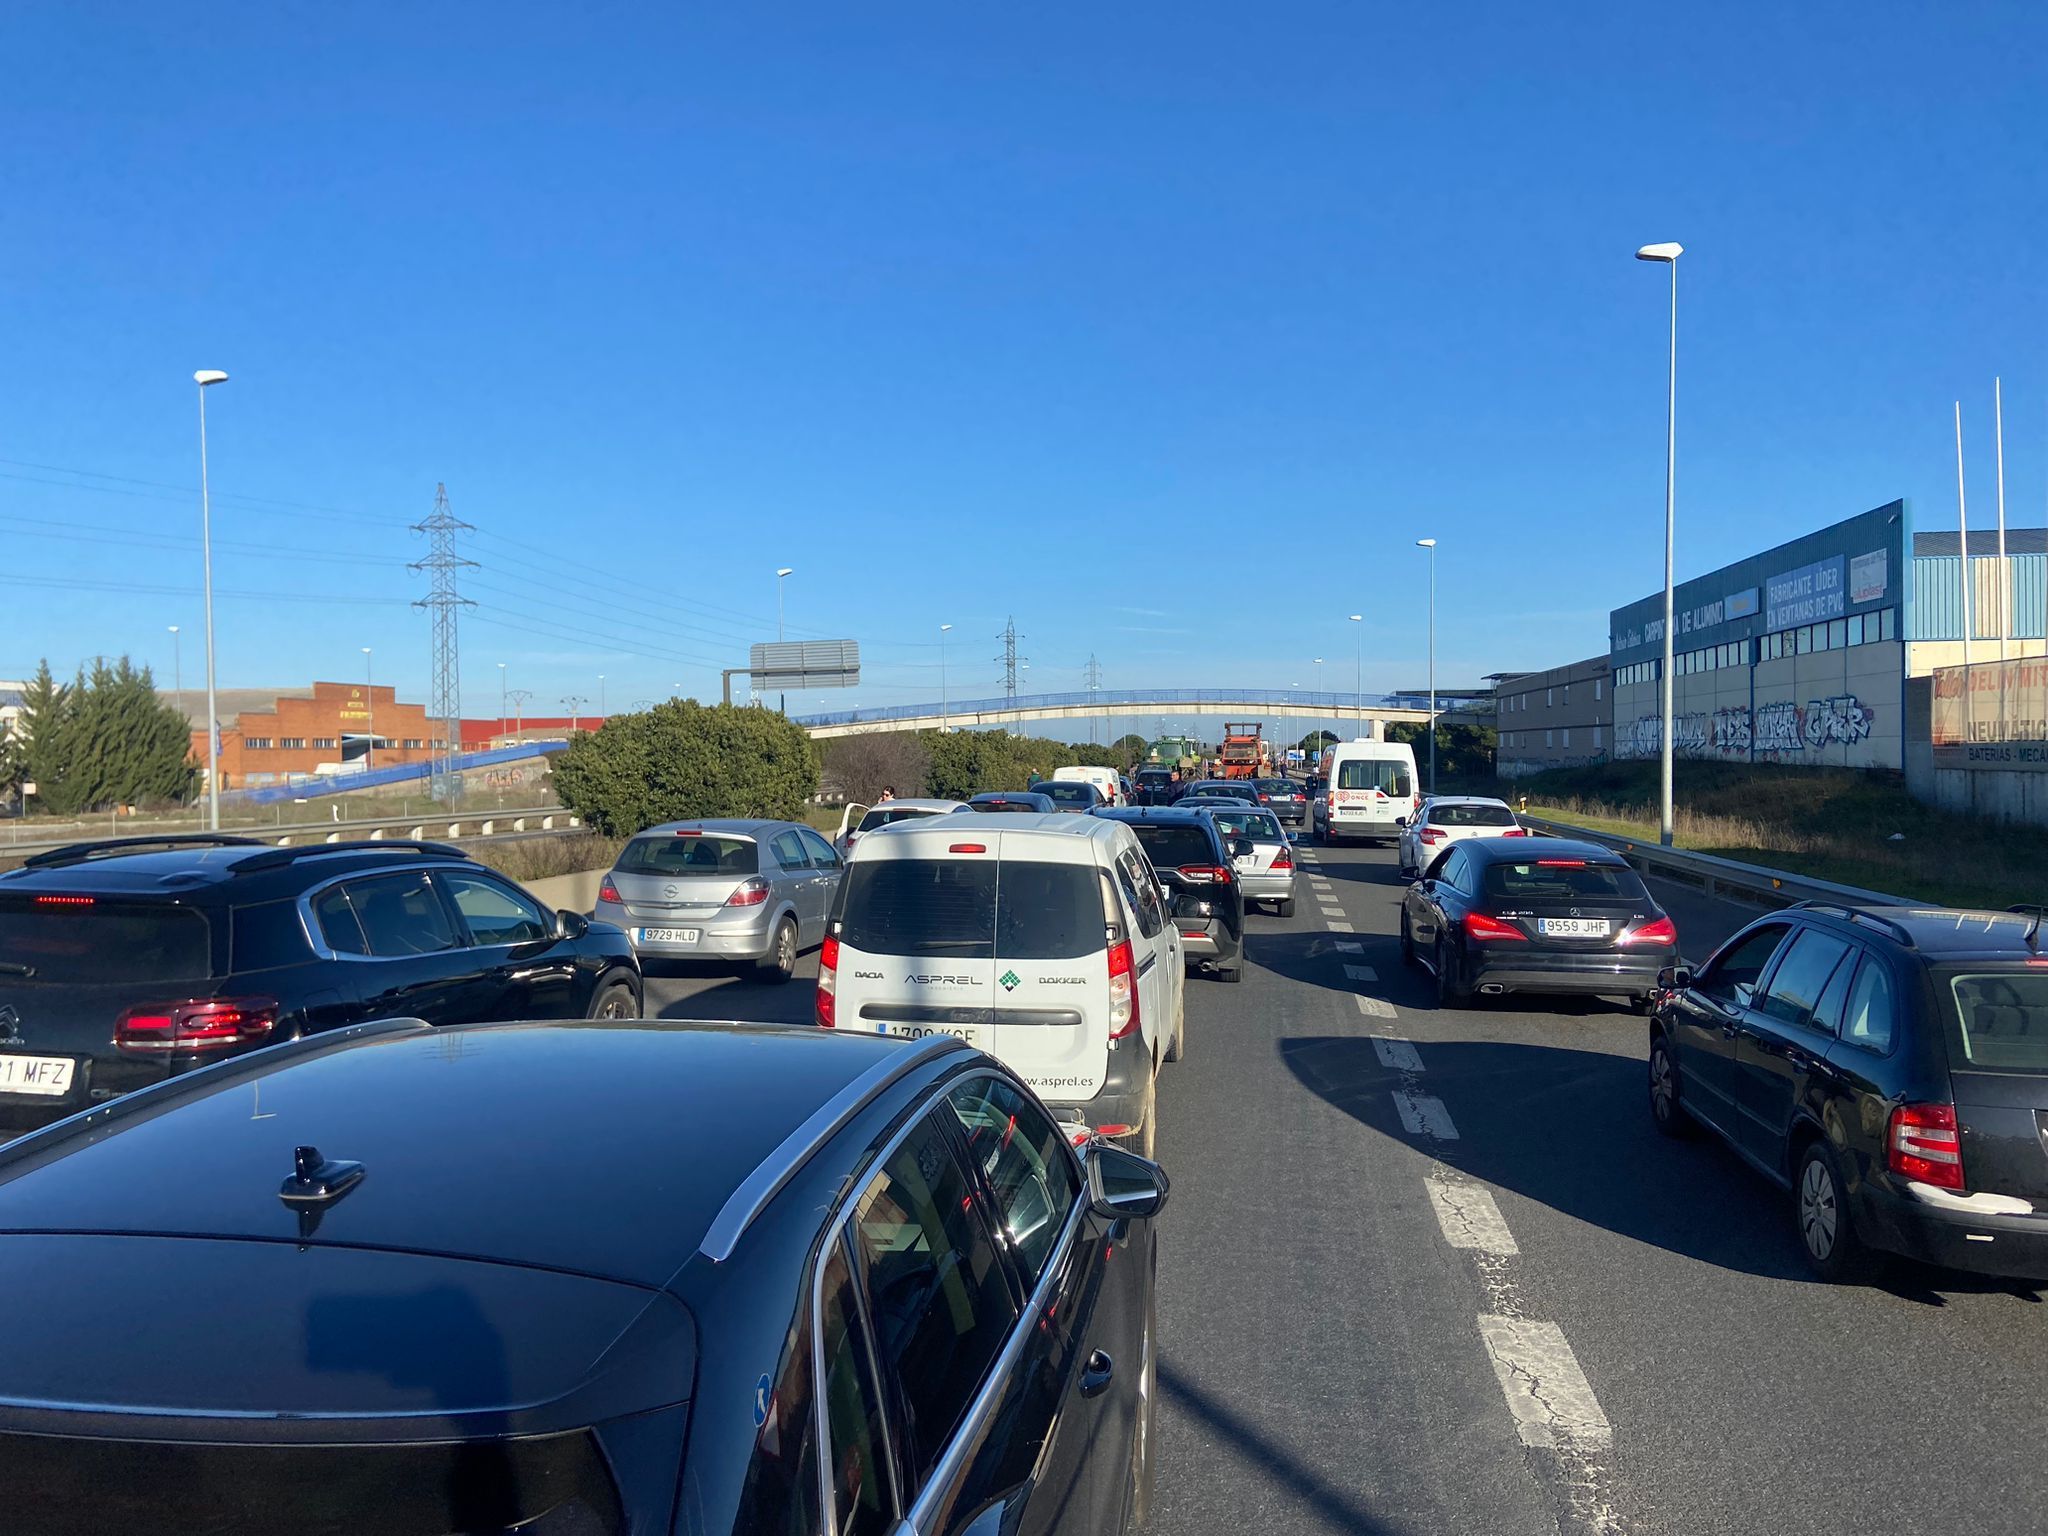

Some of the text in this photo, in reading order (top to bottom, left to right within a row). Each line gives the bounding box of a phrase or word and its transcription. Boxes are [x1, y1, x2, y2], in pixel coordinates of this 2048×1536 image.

[1770, 567, 1838, 603] FABRICANTE LÍDER
[1767, 590, 1845, 628] EN VENTANAS DE PVC
[1682, 610, 1692, 633] DE
[1969, 744, 2011, 762] BATERÍAS
[1547, 920, 1606, 933] 9559 JHF
[646, 930, 695, 941] 9729 HLD
[854, 971, 884, 980] DACIA
[904, 974, 983, 985] ASPREL
[1038, 977, 1087, 985] DOKKER
[24, 1061, 66, 1085] MFZ
